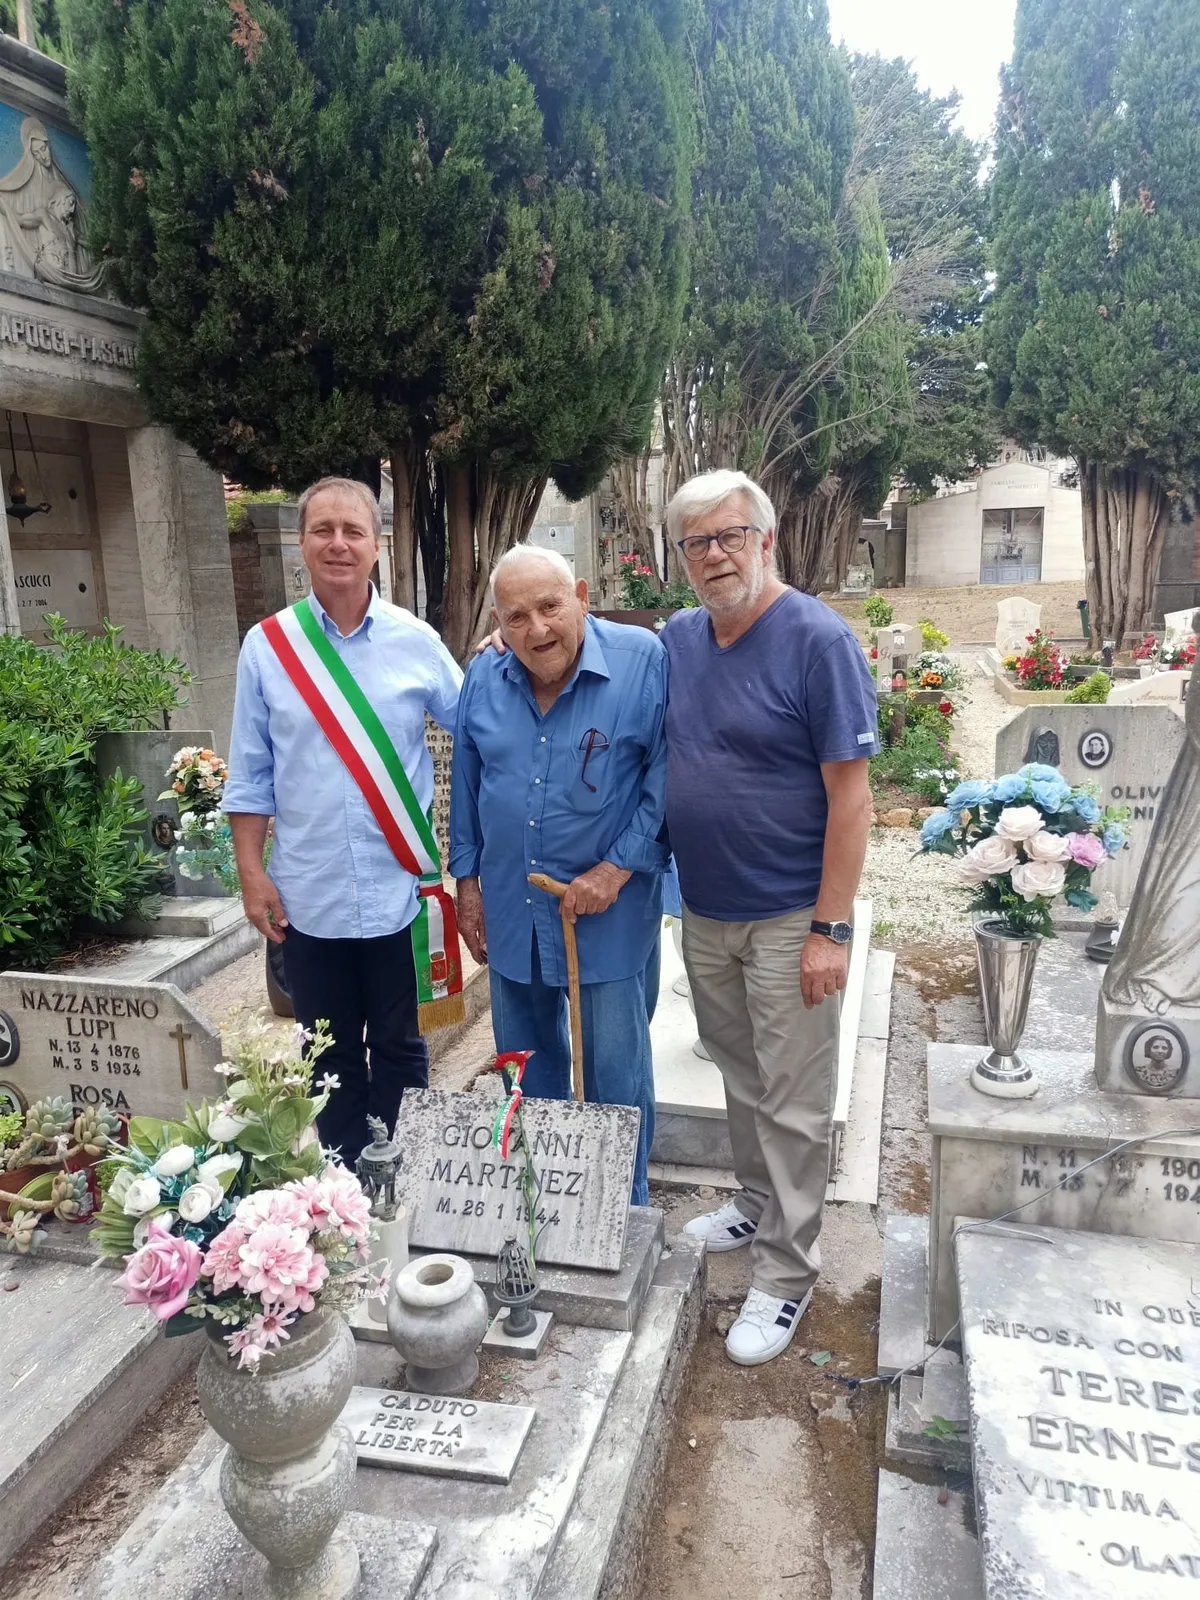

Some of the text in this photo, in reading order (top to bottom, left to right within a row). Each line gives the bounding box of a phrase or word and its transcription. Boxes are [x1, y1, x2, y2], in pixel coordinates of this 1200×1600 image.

[1111, 786, 1165, 800] OLIV
[21, 990, 159, 1020] NAZZARENO
[66, 1017, 117, 1040] LUPI
[91, 1043, 99, 1055] 4
[108, 1044, 140, 1060] 1876
[91, 1059, 99, 1072] 5
[106, 1061, 141, 1076] 1934
[70, 1084, 130, 1109] ROSA
[497, 1203, 504, 1219] 1
[516, 1205, 561, 1226] 1944
[1092, 1298, 1124, 1318] IN
[982, 1318, 1184, 1363] RIPOSA CON
[1040, 1365, 1200, 1416] TERE
[380, 1394, 478, 1417] CADUTO
[370, 1412, 463, 1438] PER LA
[1016, 1472, 1181, 1521] VITTIMA
